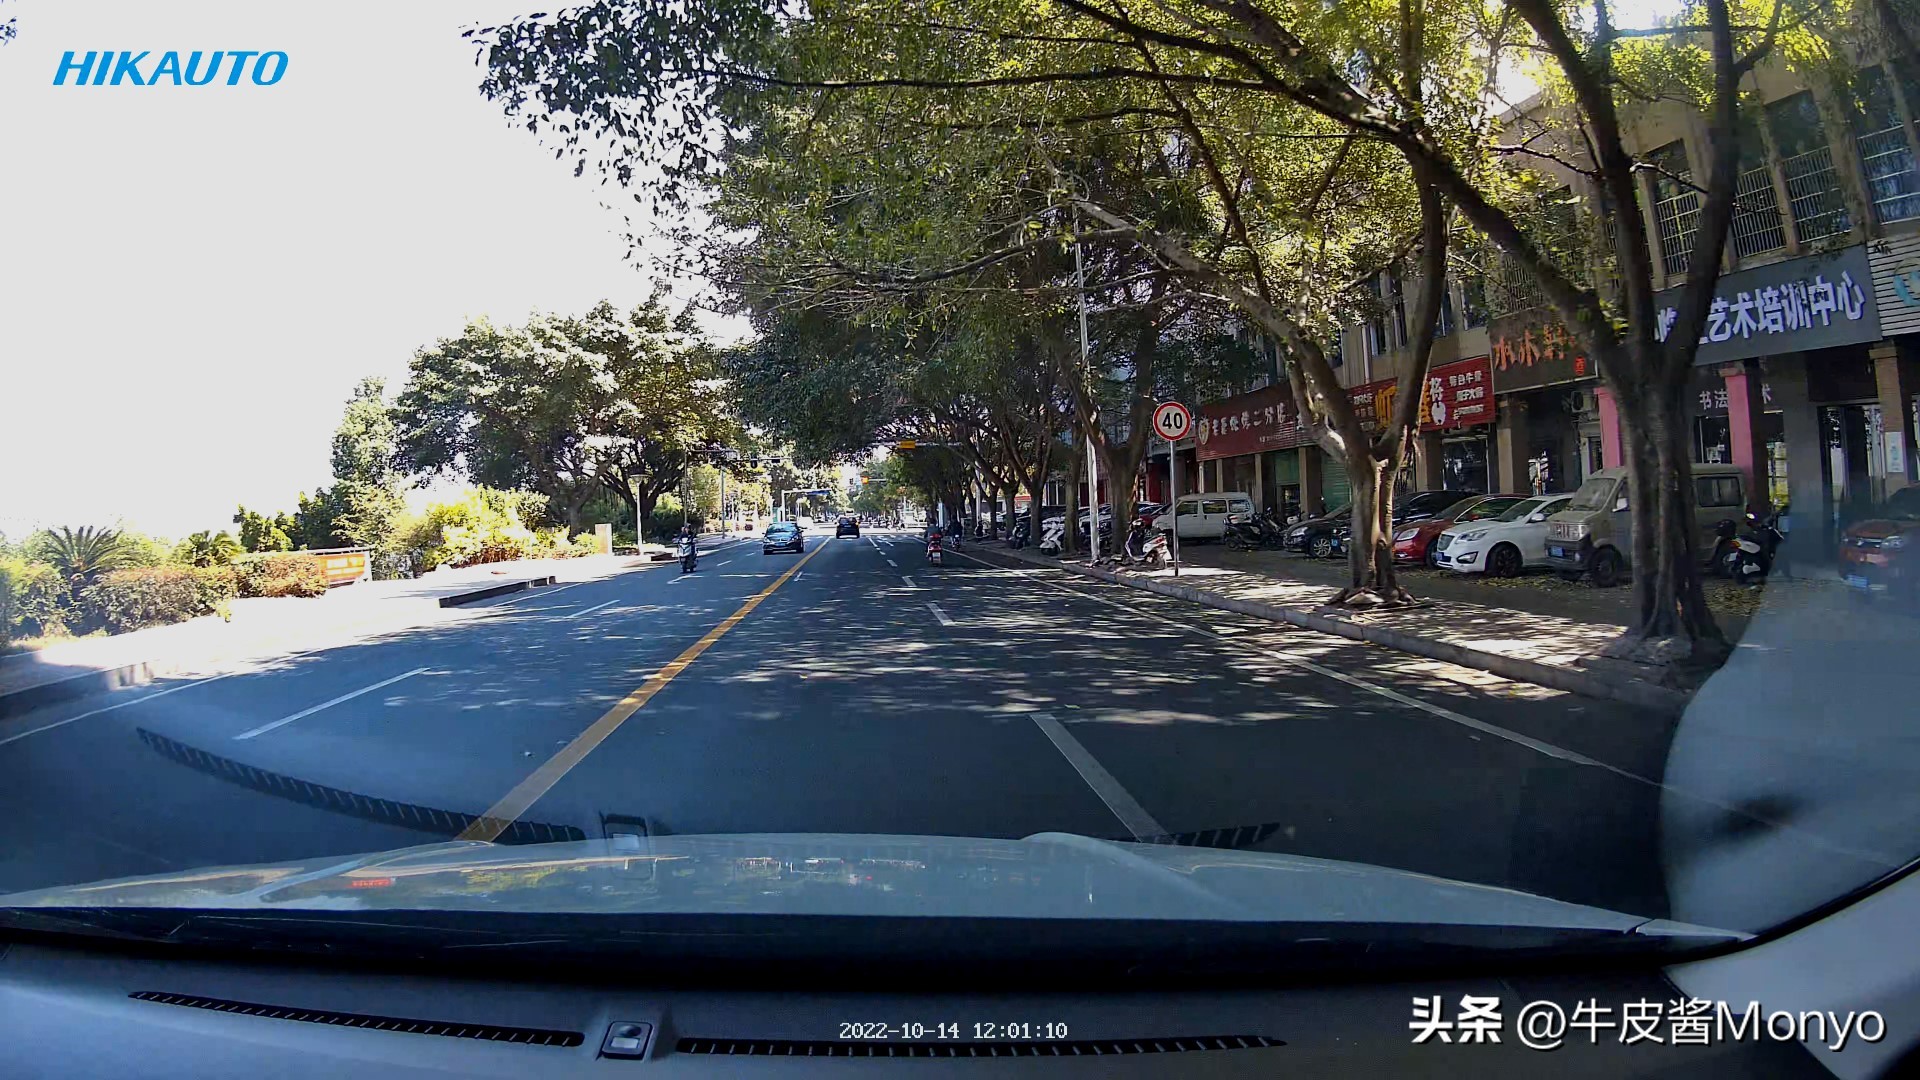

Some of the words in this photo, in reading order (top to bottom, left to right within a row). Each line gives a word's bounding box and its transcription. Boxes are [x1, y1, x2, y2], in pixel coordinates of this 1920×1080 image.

[1654, 270, 1866, 344] 艺术培训中心
[1162, 412, 1183, 430] 40
